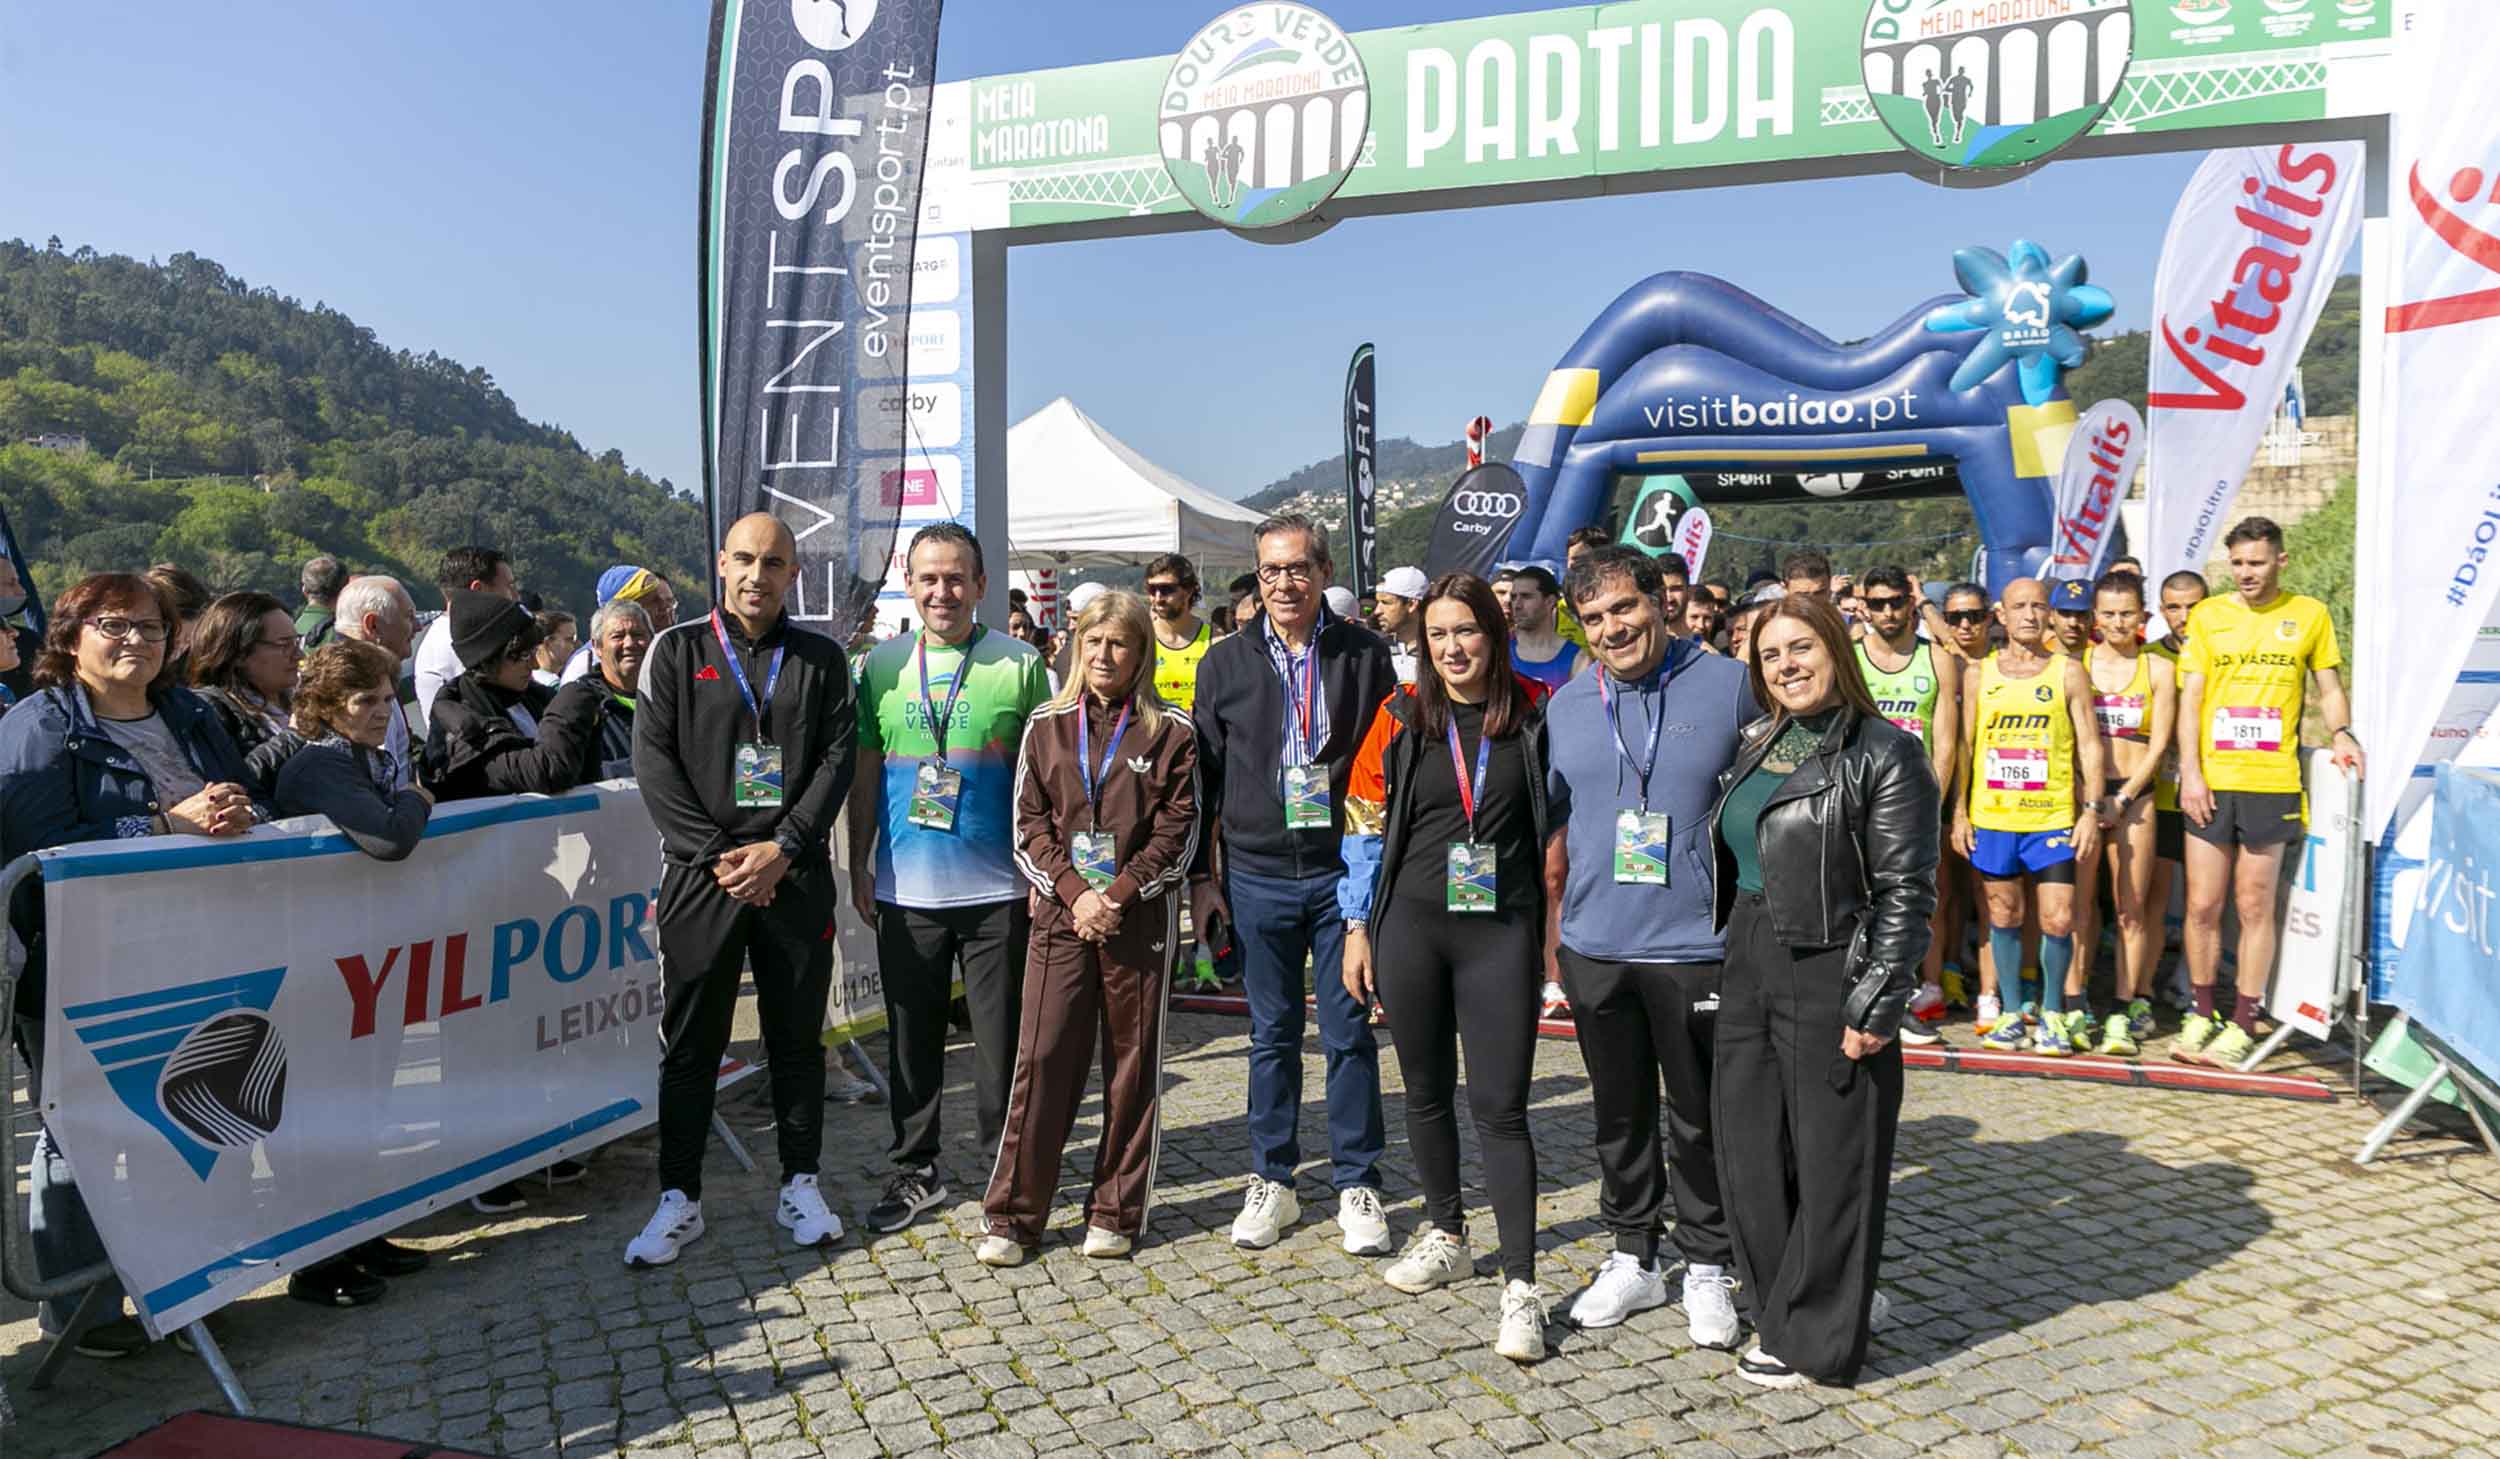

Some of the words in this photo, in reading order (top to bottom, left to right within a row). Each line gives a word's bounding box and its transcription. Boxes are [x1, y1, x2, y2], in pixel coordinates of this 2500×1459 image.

[1920, 9, 1963, 36] MEIA
[1165, 11, 1258, 112] DOURO
[1274, 7, 1360, 85] VERDE
[977, 81, 1035, 124] MEIA
[1203, 86, 1238, 108] MEIA
[1243, 70, 1322, 101] MARATONA
[1406, 8, 1795, 168] PARTIDA
[977, 114, 1109, 165] MARATONA
[863, 62, 918, 358] eventsport.pt
[2148, 143, 2337, 411] Vitalis
[1644, 390, 1919, 430] visitbaiao.pt
[2054, 416, 2132, 566] Vitalis
[1453, 521, 1492, 535] Carby
[905, 716, 969, 729] VEDE
[1877, 700, 1917, 713] mm
[2001, 766, 2030, 780] 1766
[334, 888, 660, 1040] YILPOR
[537, 978, 664, 1052] LEIXÕE
